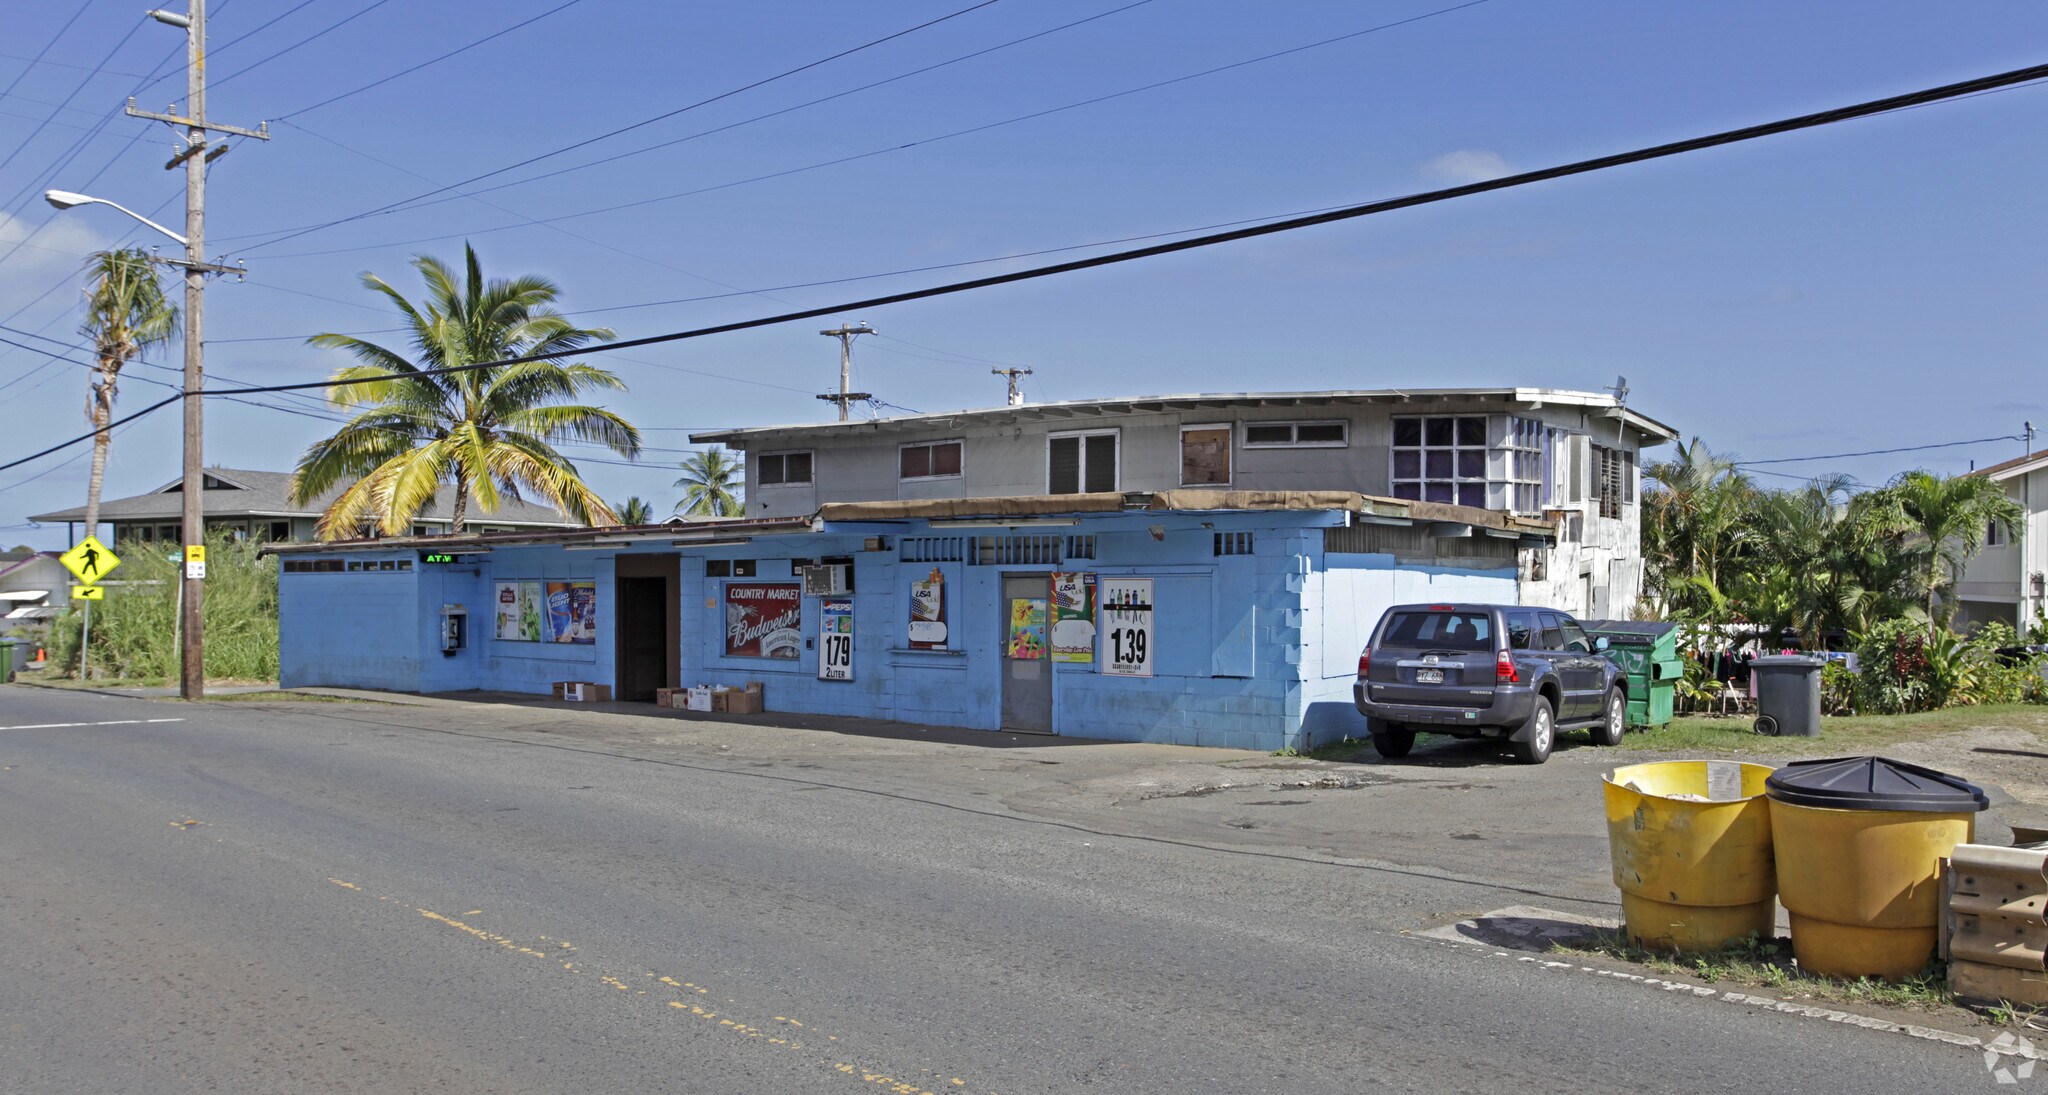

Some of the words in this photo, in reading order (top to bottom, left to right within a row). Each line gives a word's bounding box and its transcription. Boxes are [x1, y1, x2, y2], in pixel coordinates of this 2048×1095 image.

[551, 593, 569, 602] BUD
[730, 588, 766, 599] COUNTRY
[767, 588, 800, 600] MARKET
[550, 598, 571, 608] LIGHT
[831, 603, 851, 611] PEPSI
[730, 608, 800, 648] Budweiser
[826, 636, 850, 666] 1.79
[1111, 628, 1146, 663] 1.39
